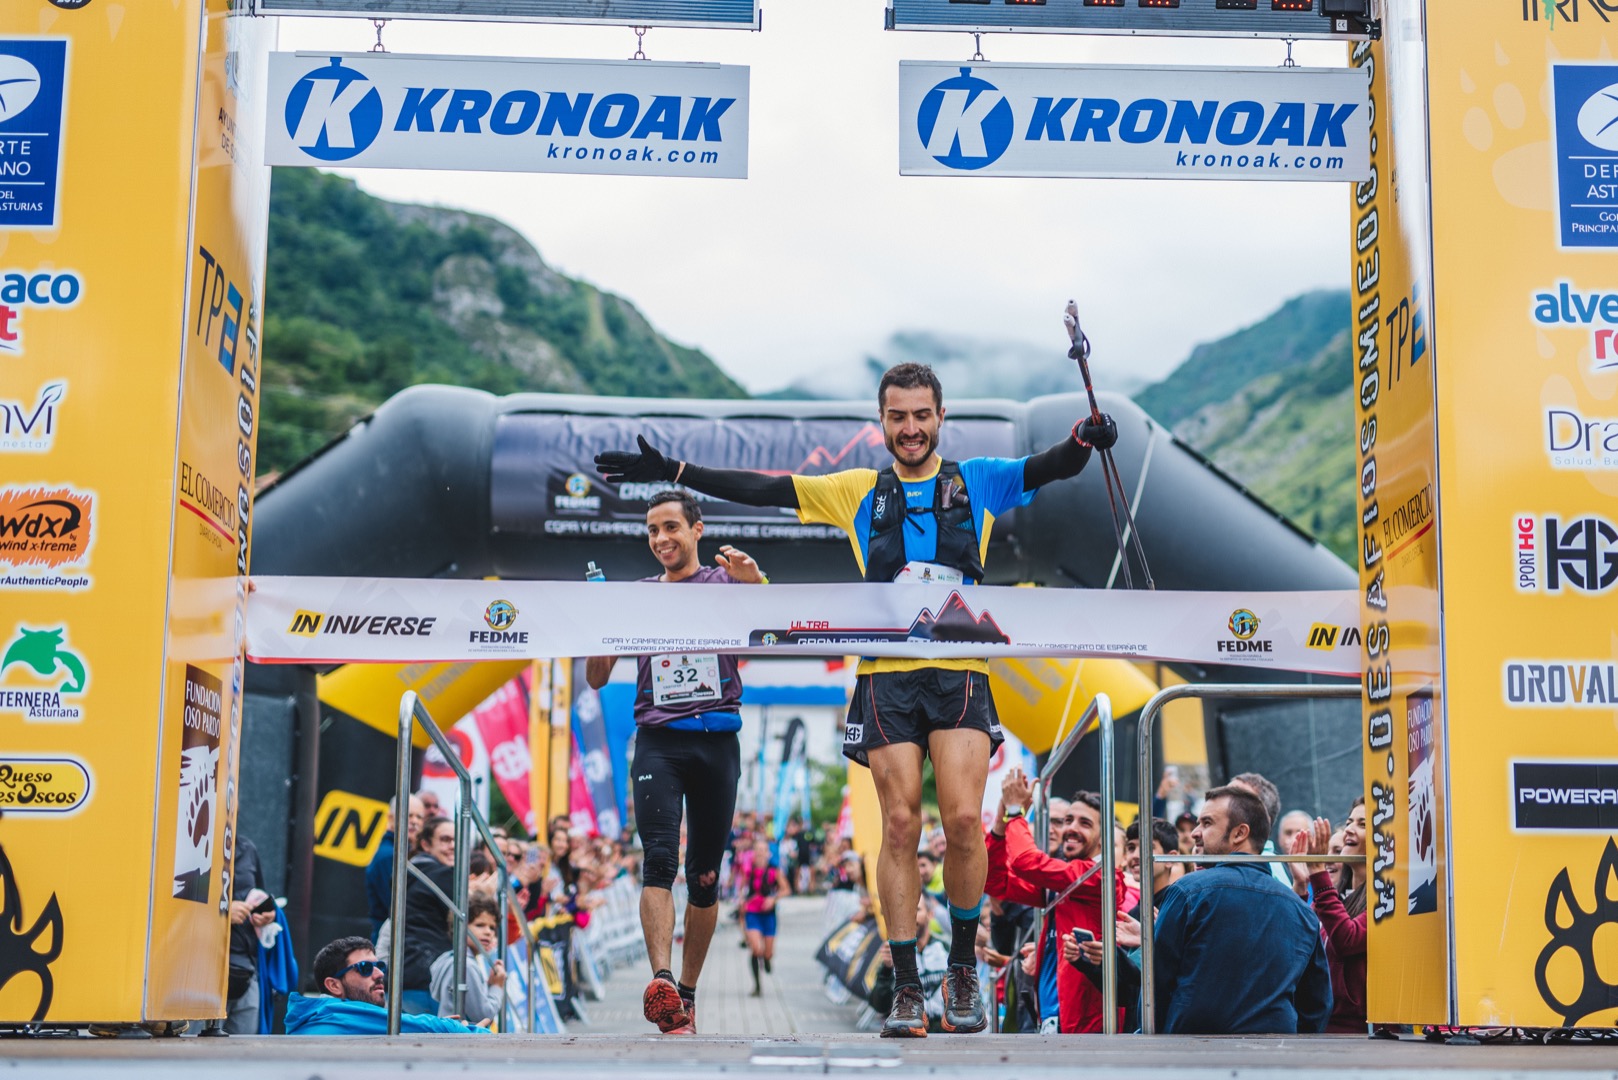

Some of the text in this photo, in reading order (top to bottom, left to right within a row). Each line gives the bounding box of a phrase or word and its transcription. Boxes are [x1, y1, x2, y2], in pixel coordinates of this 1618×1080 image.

[393, 86, 736, 142] KRONOAK
[1025, 96, 1360, 148] KRONOAK
[547, 142, 719, 164] kronoak.com
[1176, 150, 1345, 169] kronoak.com
[1, 273, 79, 304] aco
[1548, 411, 1618, 452] Dra
[180, 461, 236, 532] EL COMERCIO
[1383, 482, 1433, 549] EL COMERCIO
[1518, 518, 1536, 588] SPORT HG
[324, 615, 437, 636] INVERSE
[469, 630, 529, 644] FEDME
[790, 620, 829, 630] ULTRA
[631, 637, 684, 646] CAMPEONATO
[686, 638, 697, 646] DE
[1217, 640, 1273, 652] FEDME
[672, 668, 699, 684] 32
[1507, 664, 1618, 703] OROVAL
[29, 706, 79, 718] Asturiana
[184, 705, 221, 739] OSO PARDO
[0, 764, 53, 789] Queso
[1519, 788, 1618, 804] POWERA
[316, 806, 382, 849] IN
